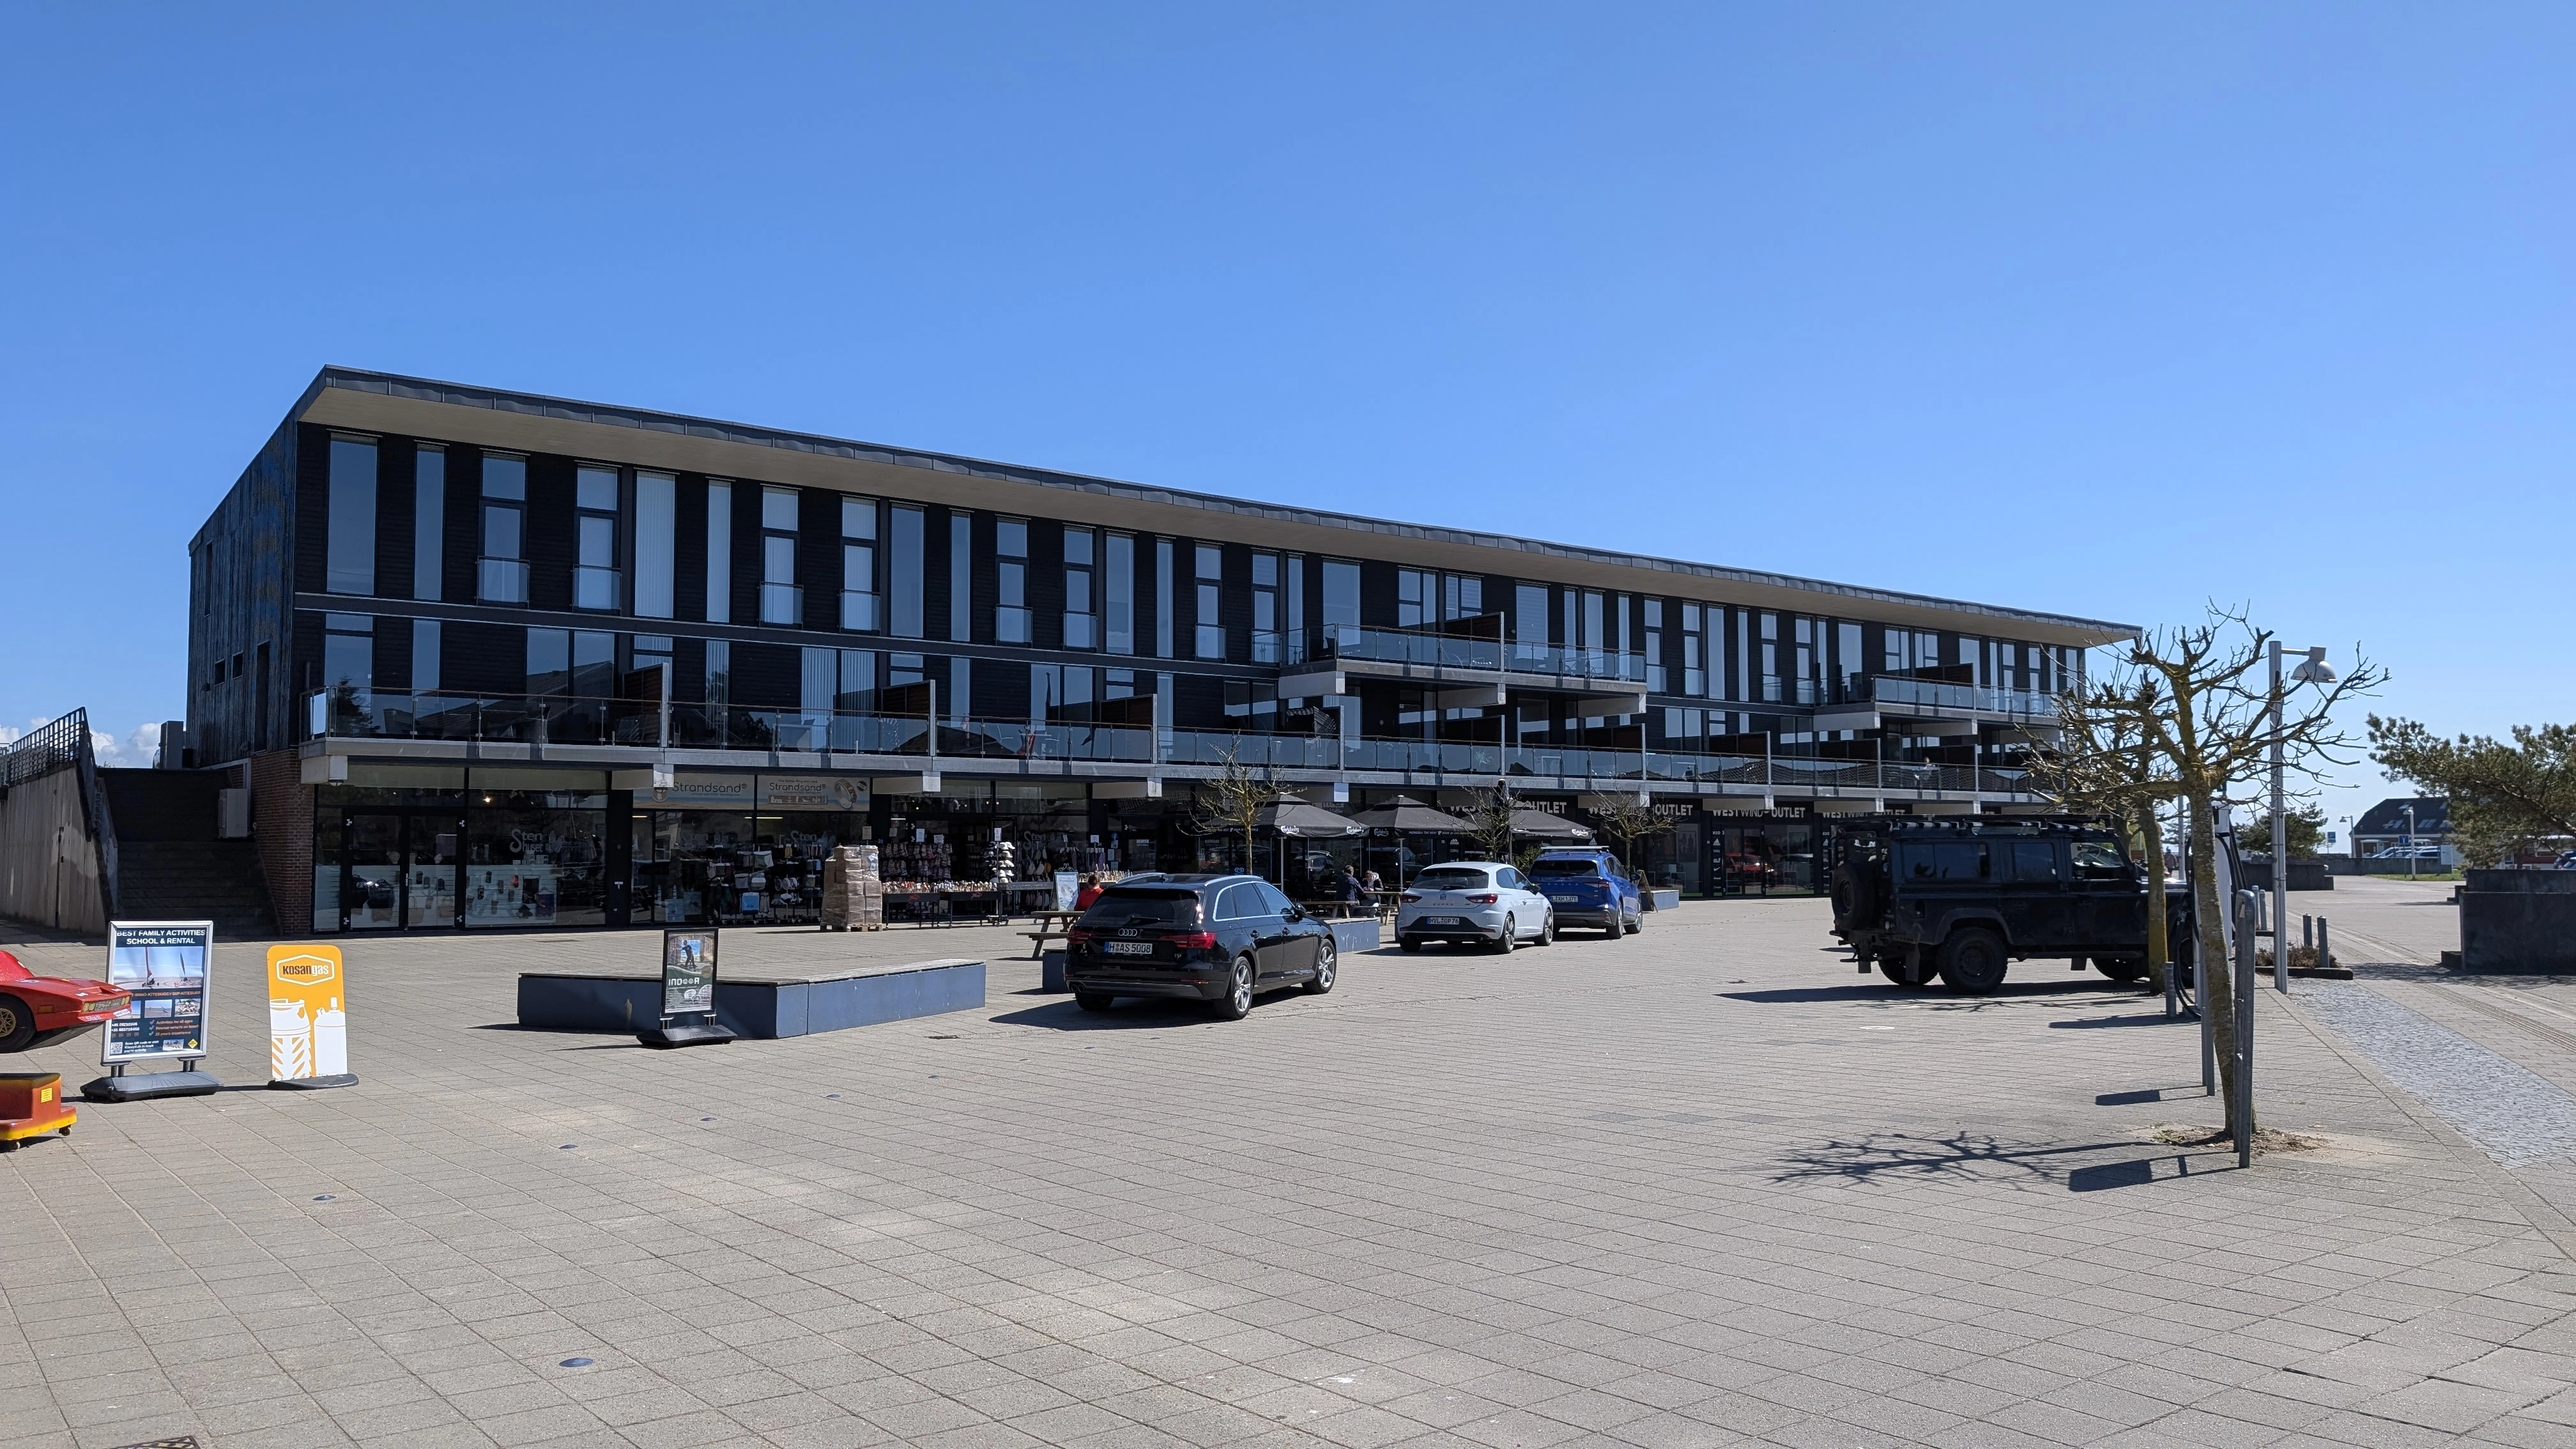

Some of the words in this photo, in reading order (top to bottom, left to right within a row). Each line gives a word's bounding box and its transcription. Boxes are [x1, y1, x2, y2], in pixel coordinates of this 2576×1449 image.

[1655, 803, 1693, 816] OUTLET
[1771, 807, 1805, 818] OUTLET
[510, 828, 543, 853] Sten
[1108, 943, 1115, 952] H
[1120, 944, 1130, 953] AS
[1131, 944, 1151, 953] 5008
